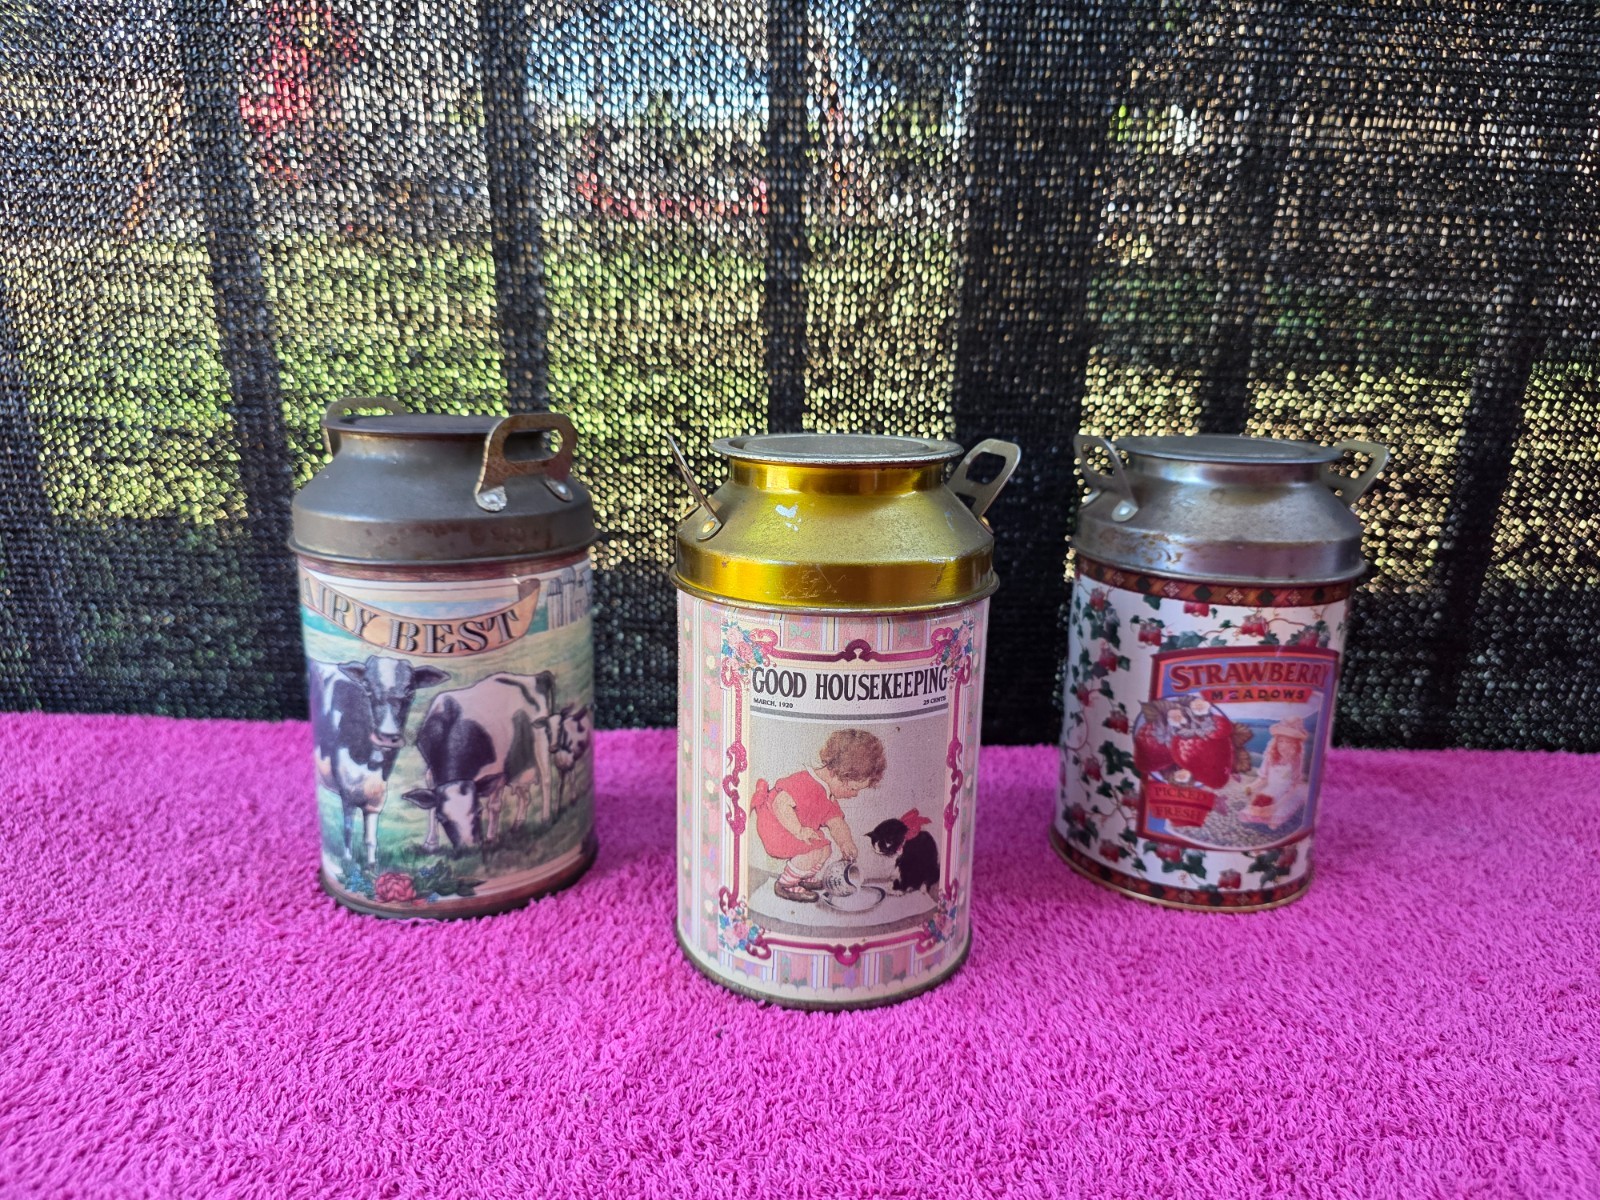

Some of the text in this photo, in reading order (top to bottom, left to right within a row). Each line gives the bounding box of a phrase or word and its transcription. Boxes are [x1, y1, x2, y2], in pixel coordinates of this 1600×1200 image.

[389, 609, 520, 654] BEST
[753, 665, 948, 701] GOOD HOUSEKEEPING
[1211, 688, 1305, 700] MEADOWS
[753, 697, 794, 709] MARCH, 1920
[1154, 786, 1207, 801] PICKED
[1156, 806, 1201, 820] FRESH
